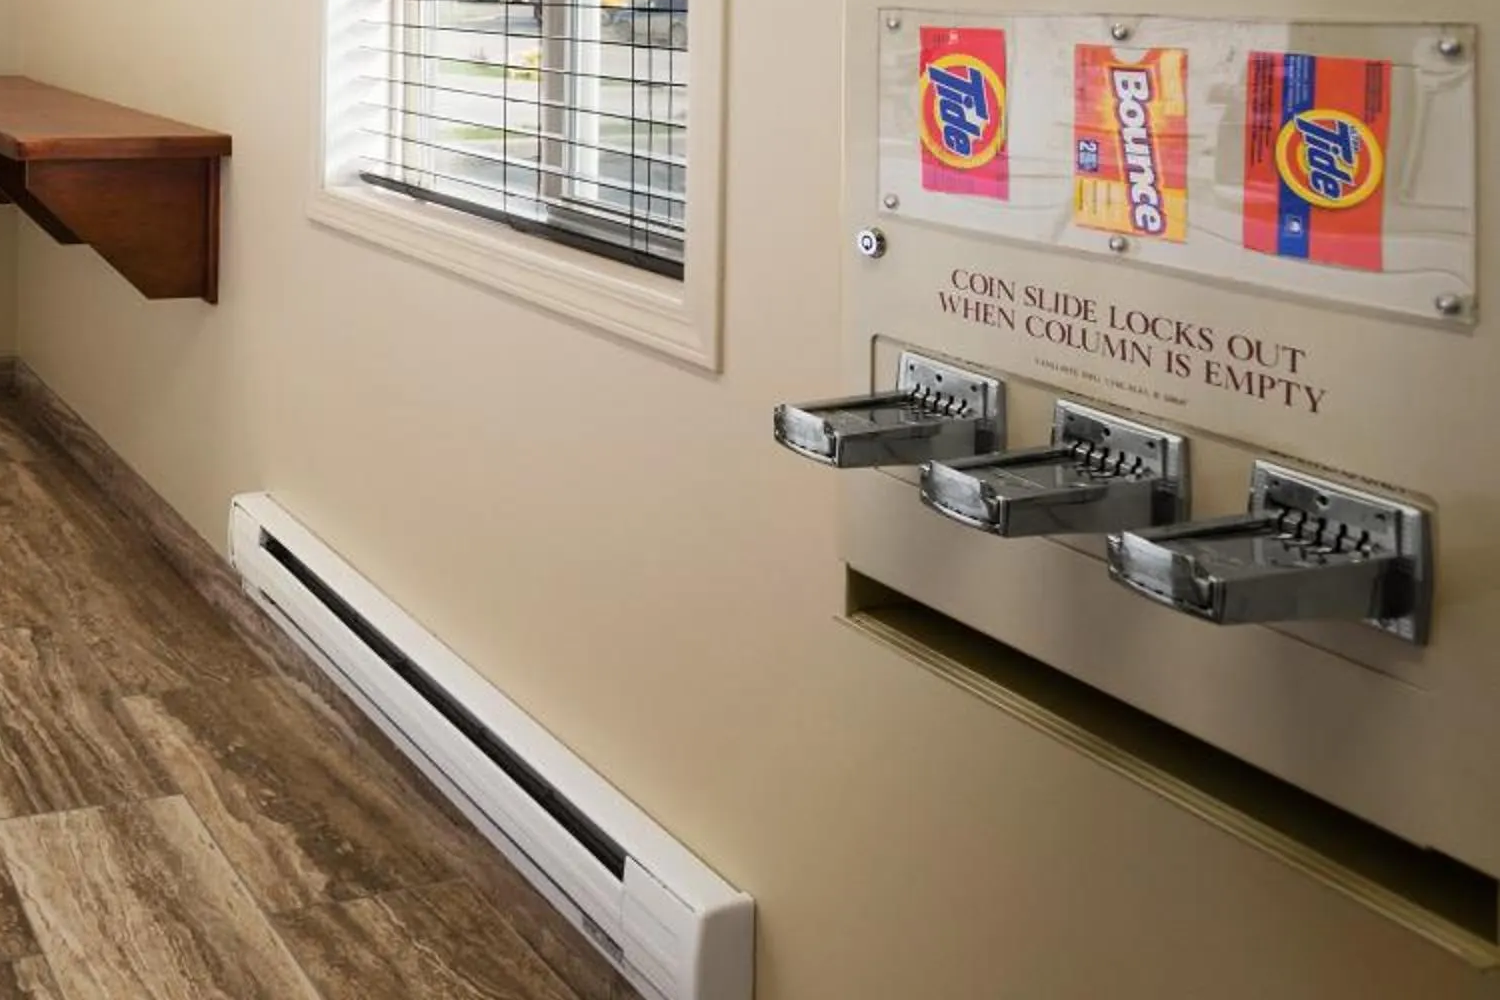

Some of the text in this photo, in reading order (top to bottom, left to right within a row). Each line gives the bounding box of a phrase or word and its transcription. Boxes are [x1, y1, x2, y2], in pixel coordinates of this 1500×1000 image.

[926, 64, 990, 158] Tide
[1112, 68, 1164, 235] Bounce
[1294, 115, 1355, 201] Tide
[939, 291, 1016, 332] WHEN
[1025, 314, 1153, 368] COLUMN
[1166, 349, 1192, 379] IS
[1205, 363, 1328, 414] EMPTY
[951, 269, 1306, 374] COIN SLIDE LOCKS OUT
